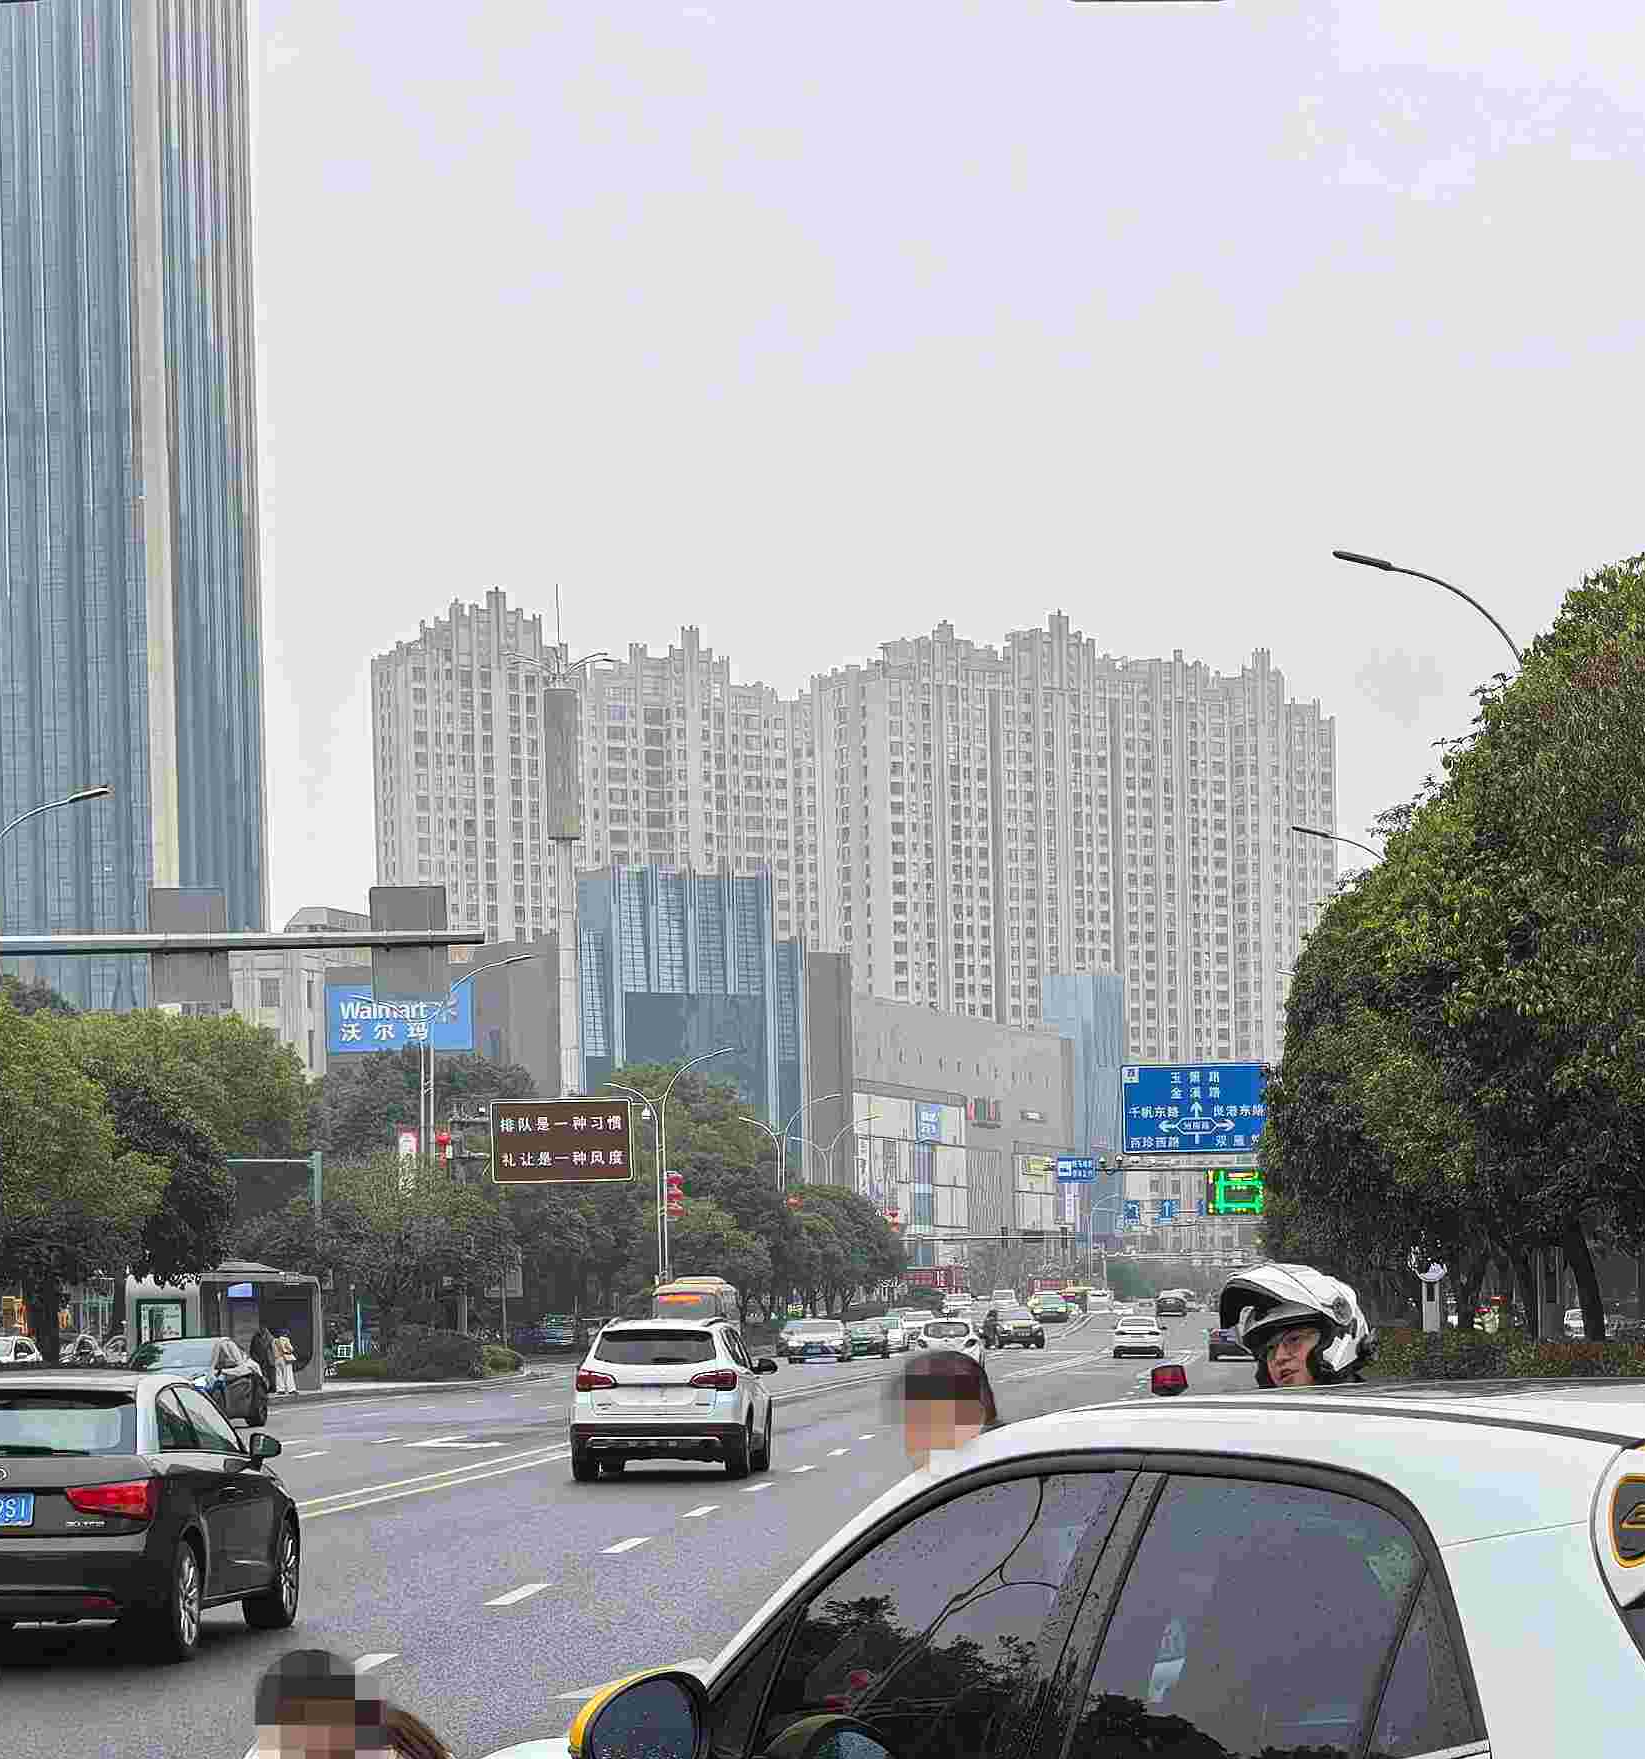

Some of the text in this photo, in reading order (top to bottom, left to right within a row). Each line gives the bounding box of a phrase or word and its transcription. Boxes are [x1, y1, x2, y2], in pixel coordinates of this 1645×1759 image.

[339, 1001, 429, 1021] Walmart
[340, 1022, 429, 1041] 沃尔玛
[499, 1115, 623, 1133] 排队是一种习惯
[502, 1149, 624, 1168] 礼让是一种风度
